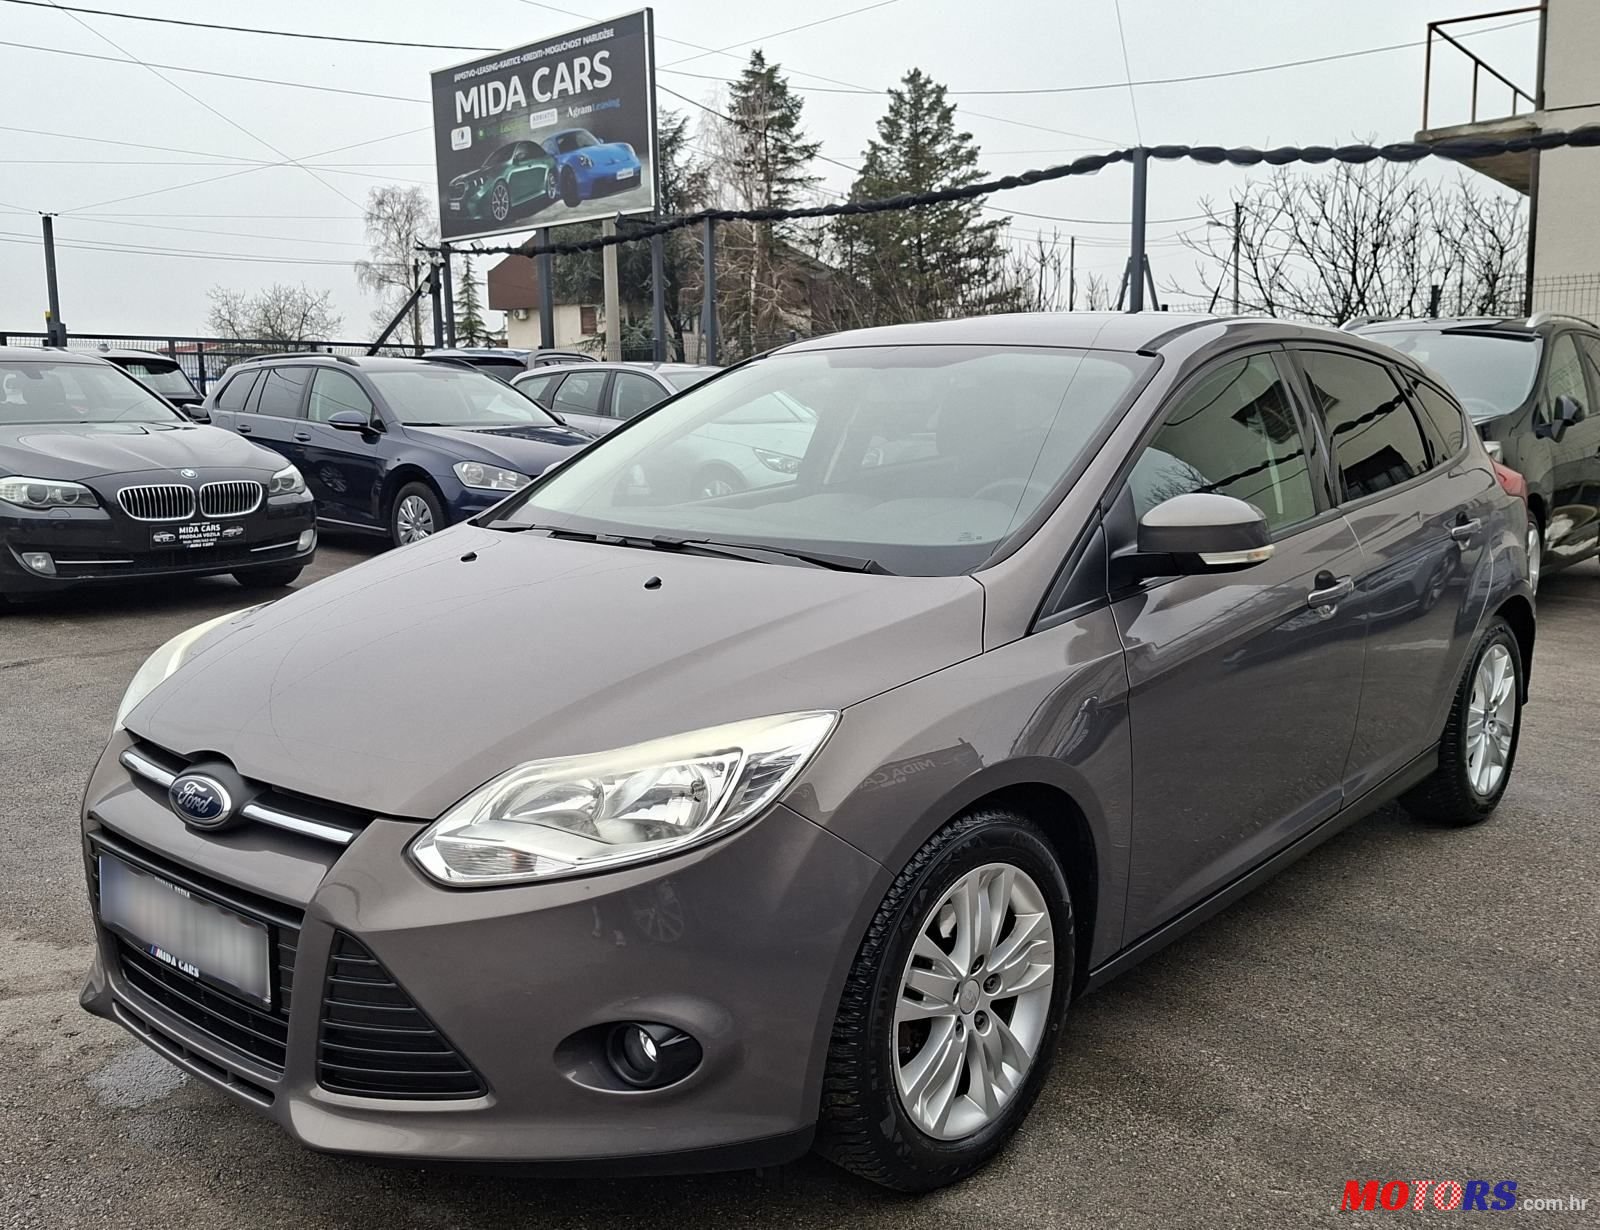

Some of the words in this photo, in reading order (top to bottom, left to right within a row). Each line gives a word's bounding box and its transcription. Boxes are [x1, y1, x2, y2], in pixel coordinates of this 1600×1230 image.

[456, 76, 527, 124] MIDA
[532, 50, 612, 102] CARS
[178, 781, 213, 814] Ford
[156, 948, 176, 966] MIDA
[178, 960, 200, 978] CARS
